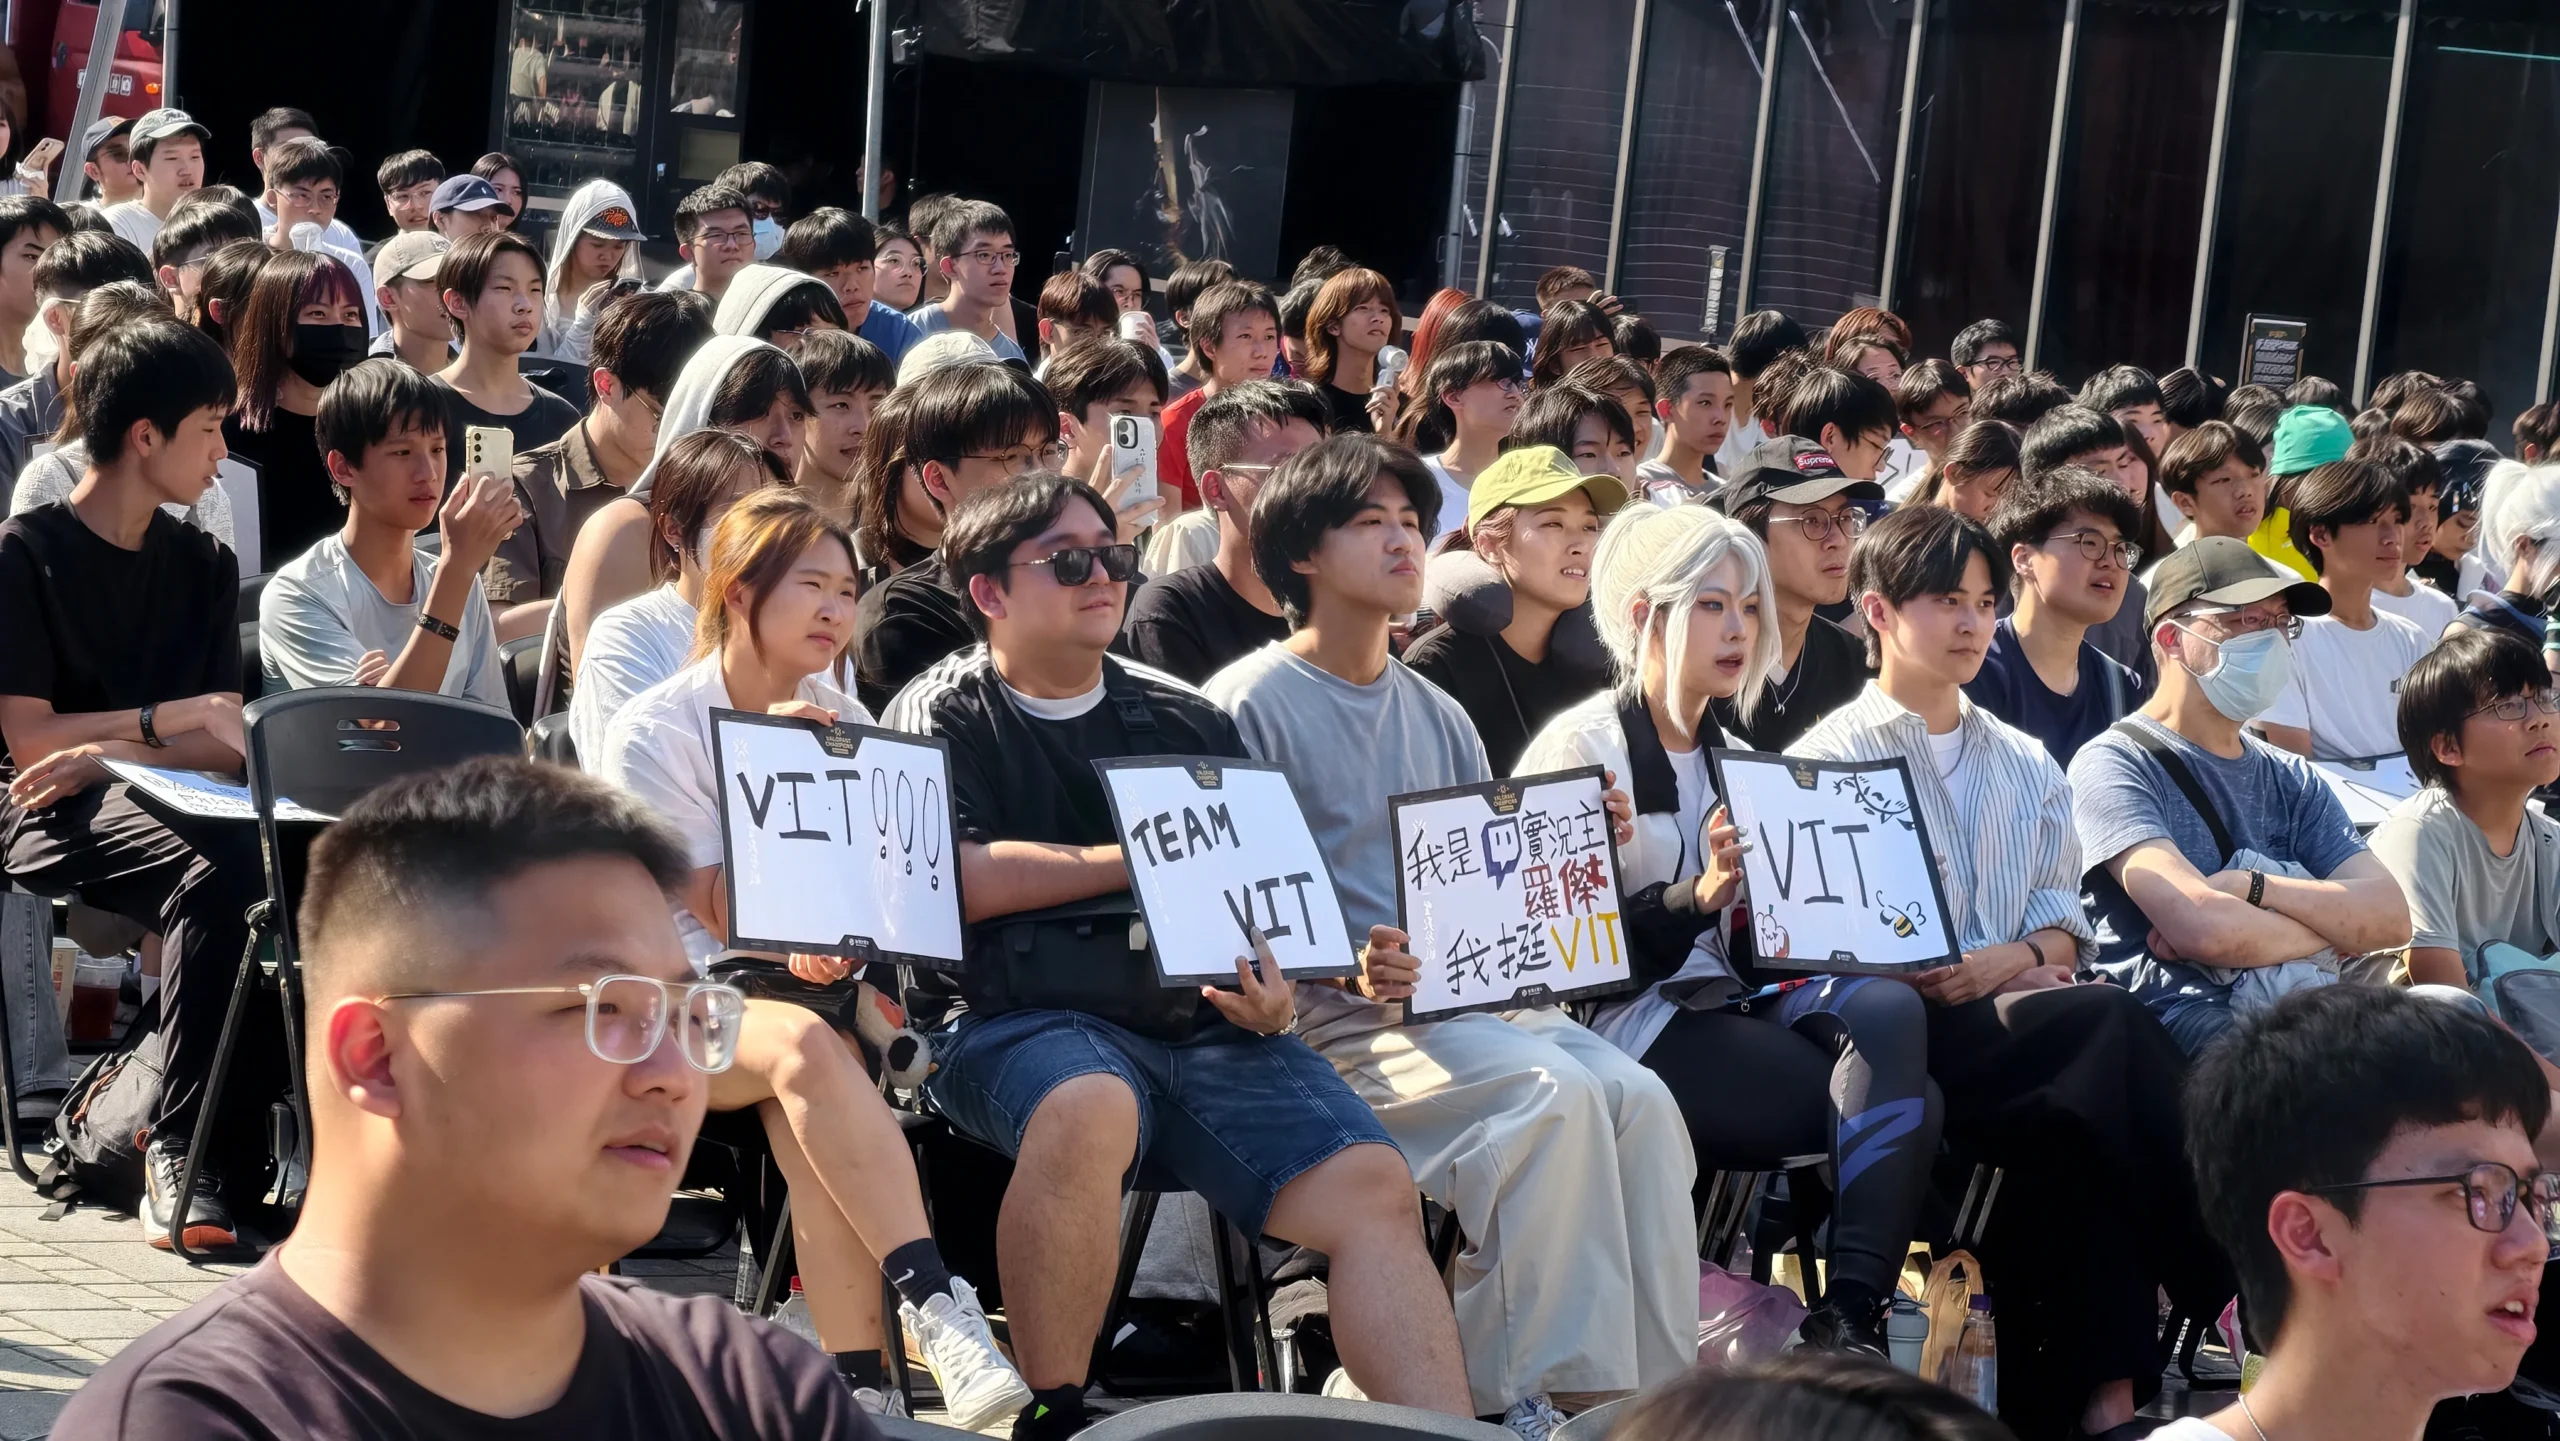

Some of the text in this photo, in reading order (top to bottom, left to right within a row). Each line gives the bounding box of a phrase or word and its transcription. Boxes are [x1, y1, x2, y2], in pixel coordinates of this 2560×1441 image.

[1130, 802, 1241, 867] TEAM
[1407, 827, 1481, 890] 我是
[1759, 818, 1870, 909] VIT
[1223, 871, 1317, 947] VIT
[1522, 853, 1608, 920] 羅傑
